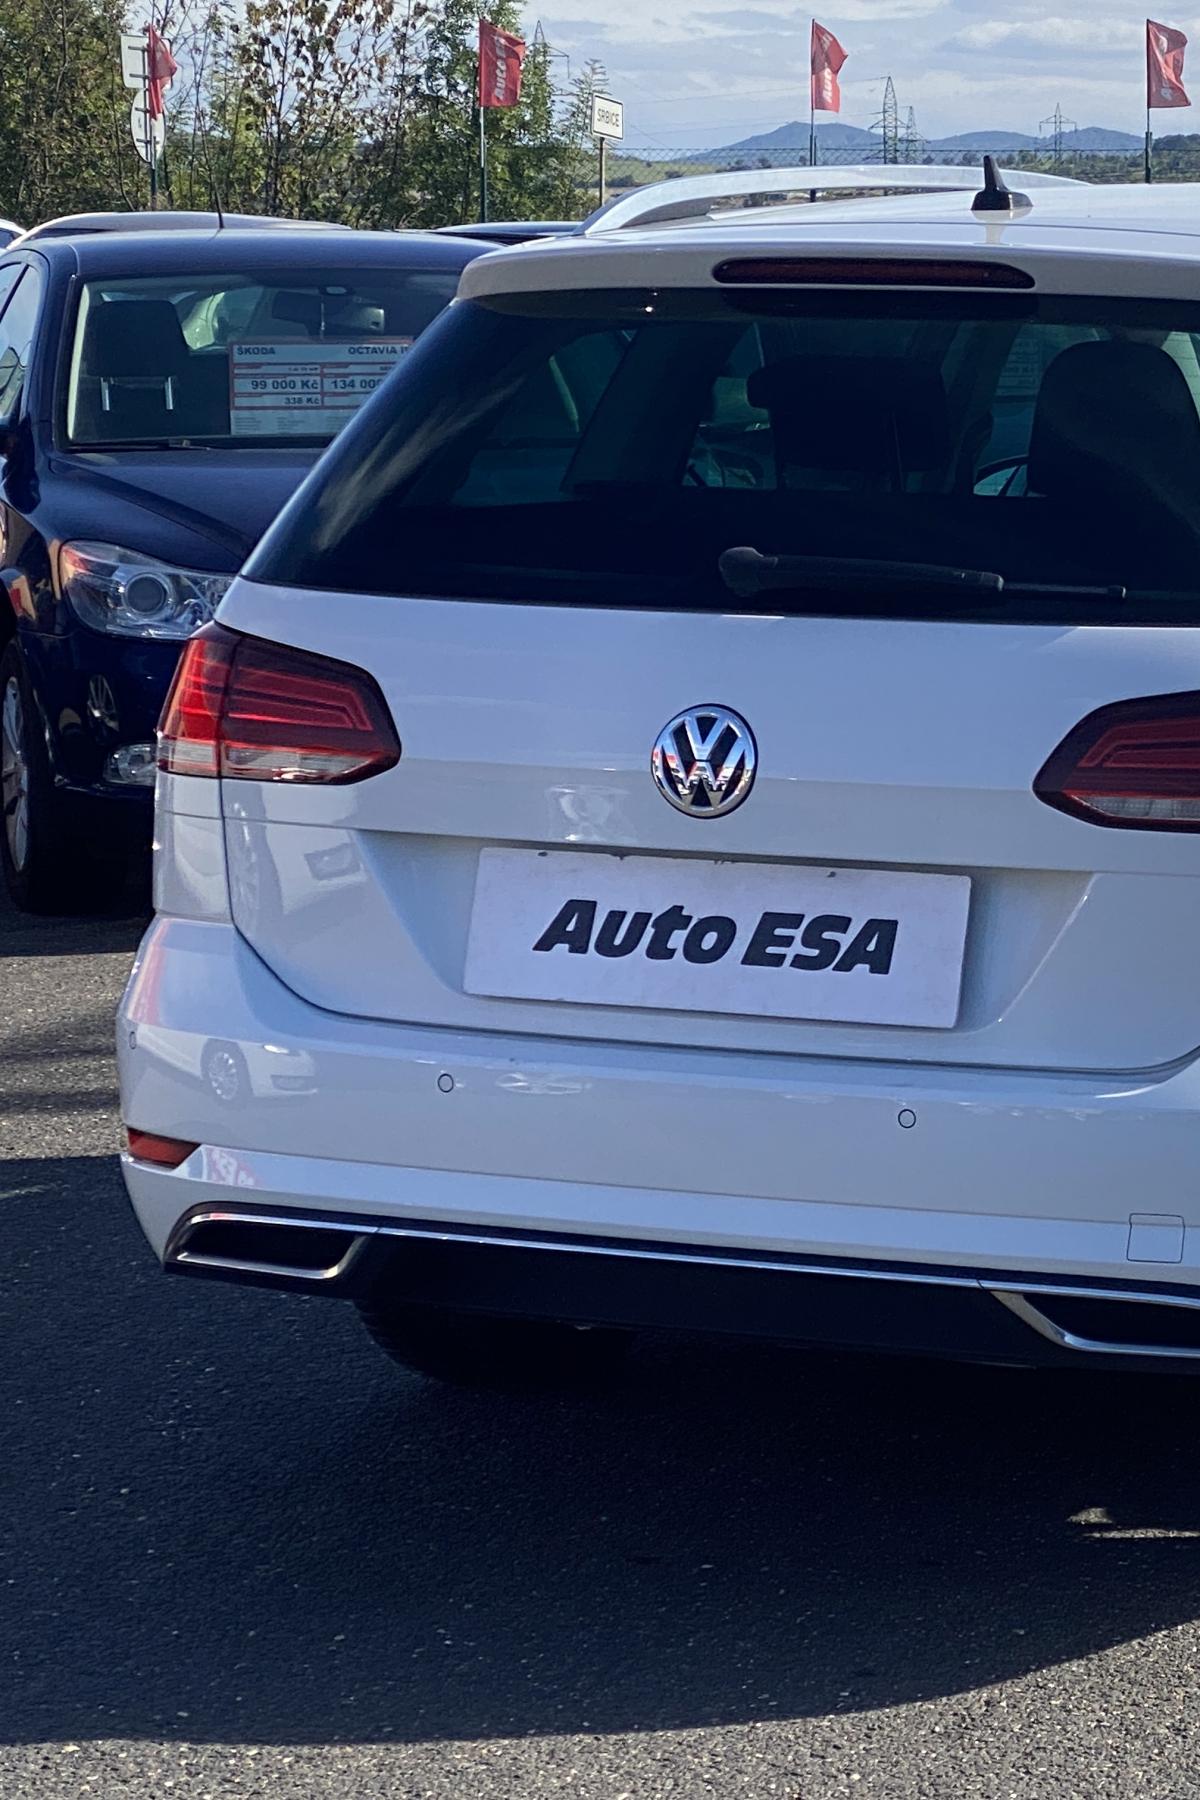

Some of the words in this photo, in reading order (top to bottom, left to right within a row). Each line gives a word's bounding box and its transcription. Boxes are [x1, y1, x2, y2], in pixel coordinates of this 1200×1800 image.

[347, 346, 398, 355] OCTAVIA
[251, 380, 267, 390] 99
[271, 380, 296, 390] 000
[300, 379, 319, 390] Kč
[331, 379, 355, 389] 134
[532, 898, 738, 965] Auto
[740, 912, 899, 975] ESA
